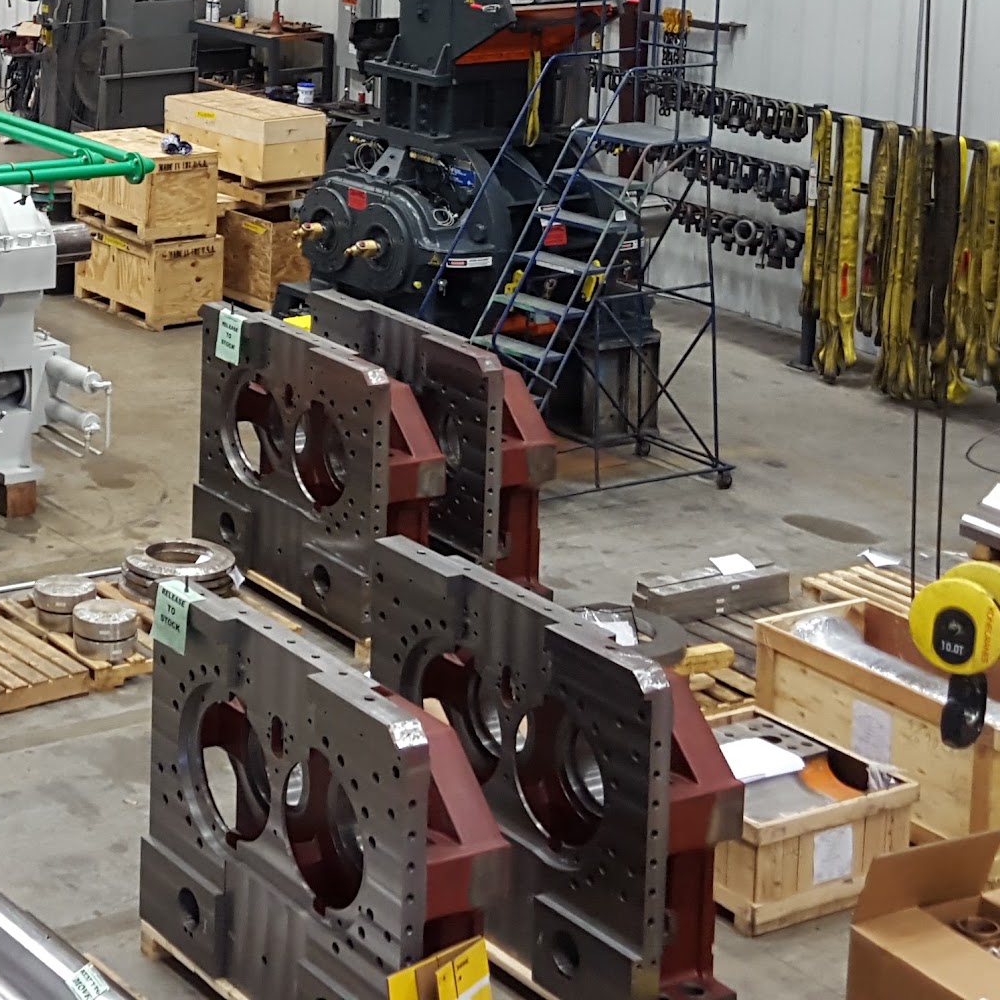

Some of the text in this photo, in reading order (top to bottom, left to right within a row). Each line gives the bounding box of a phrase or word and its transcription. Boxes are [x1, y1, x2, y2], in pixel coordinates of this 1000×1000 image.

[225, 331, 232, 339] TO
[221, 339, 236, 350] STOCK
[161, 588, 186, 608] RELEASE
[167, 604, 176, 615] TO
[160, 614, 181, 633] STOCK
[941, 640, 965, 656] 10.0T
